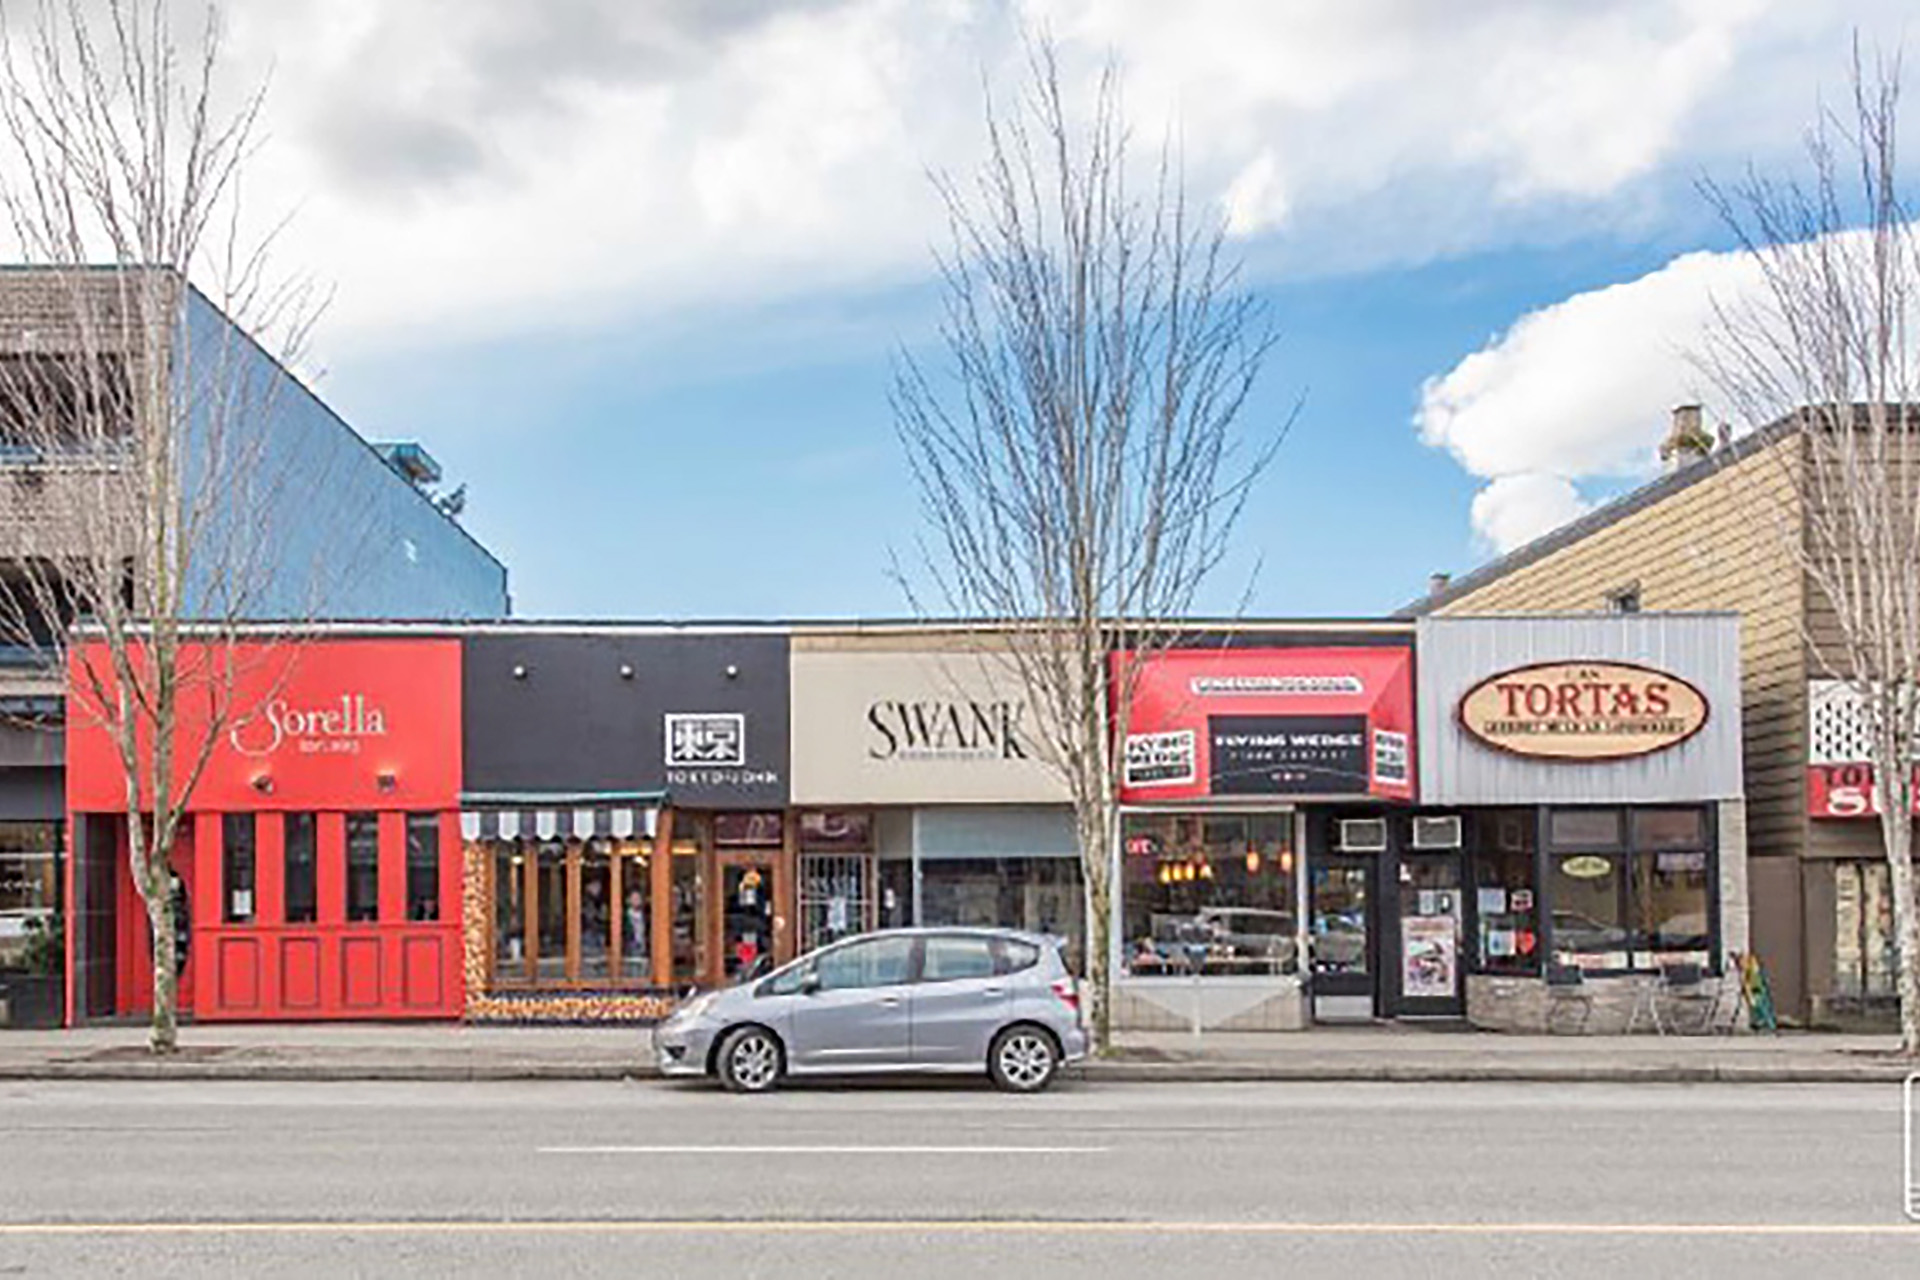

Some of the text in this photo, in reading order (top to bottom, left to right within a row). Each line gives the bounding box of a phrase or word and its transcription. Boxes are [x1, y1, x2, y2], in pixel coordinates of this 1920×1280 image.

[1496, 683, 1671, 718] TORTAS
[229, 693, 387, 757] Sorella
[868, 701, 1028, 760] SWANK
[1289, 734, 1363, 747] WEDGE
